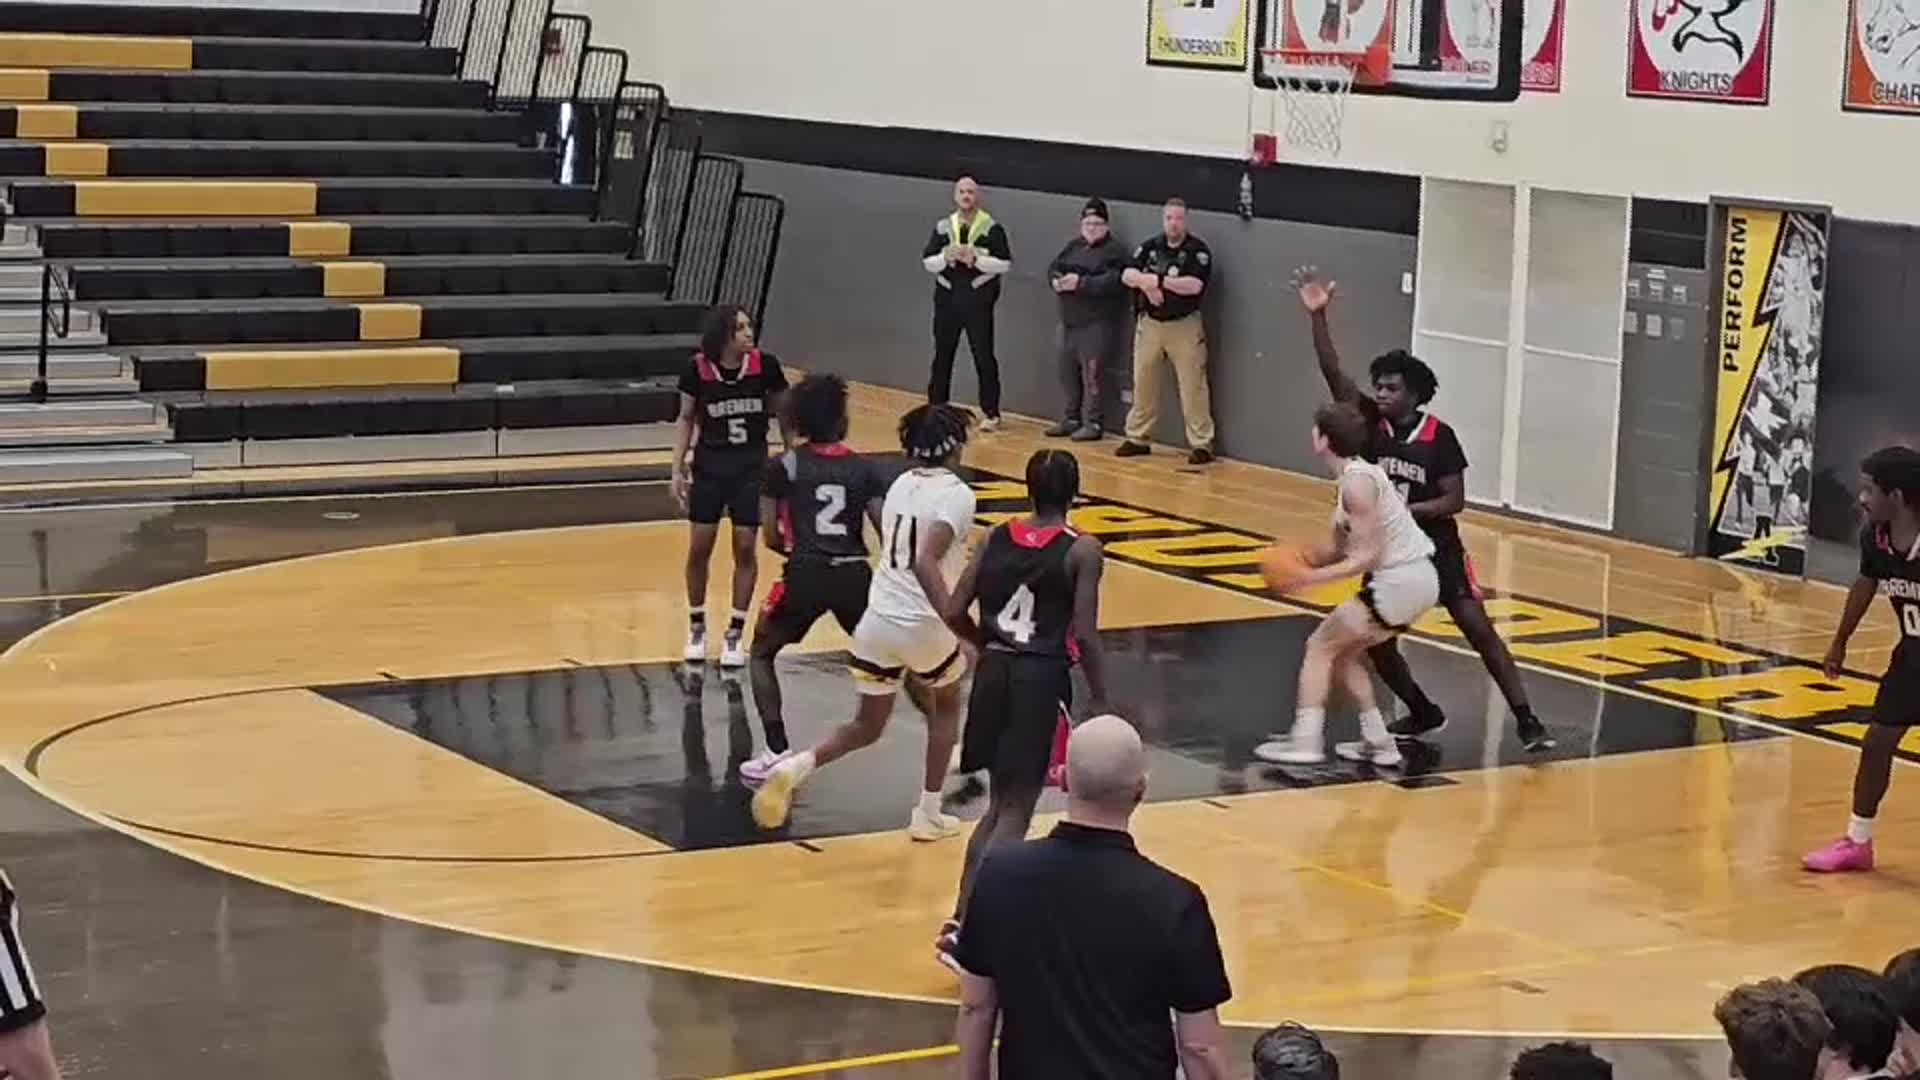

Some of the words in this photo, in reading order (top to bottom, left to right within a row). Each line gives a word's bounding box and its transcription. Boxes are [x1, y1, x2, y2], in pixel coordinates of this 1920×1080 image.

[1158, 37, 1237, 57] THUNDERBOLTS
[1661, 71, 1733, 92] KNIGHTS
[1723, 217, 1747, 372] PERFORM
[707, 398, 763, 417] BREMEN
[727, 418, 748, 444] 5
[816, 484, 847, 536] 2
[890, 513, 917, 570] 11
[998, 584, 1036, 643] 4
[1903, 604, 1920, 637] 0
